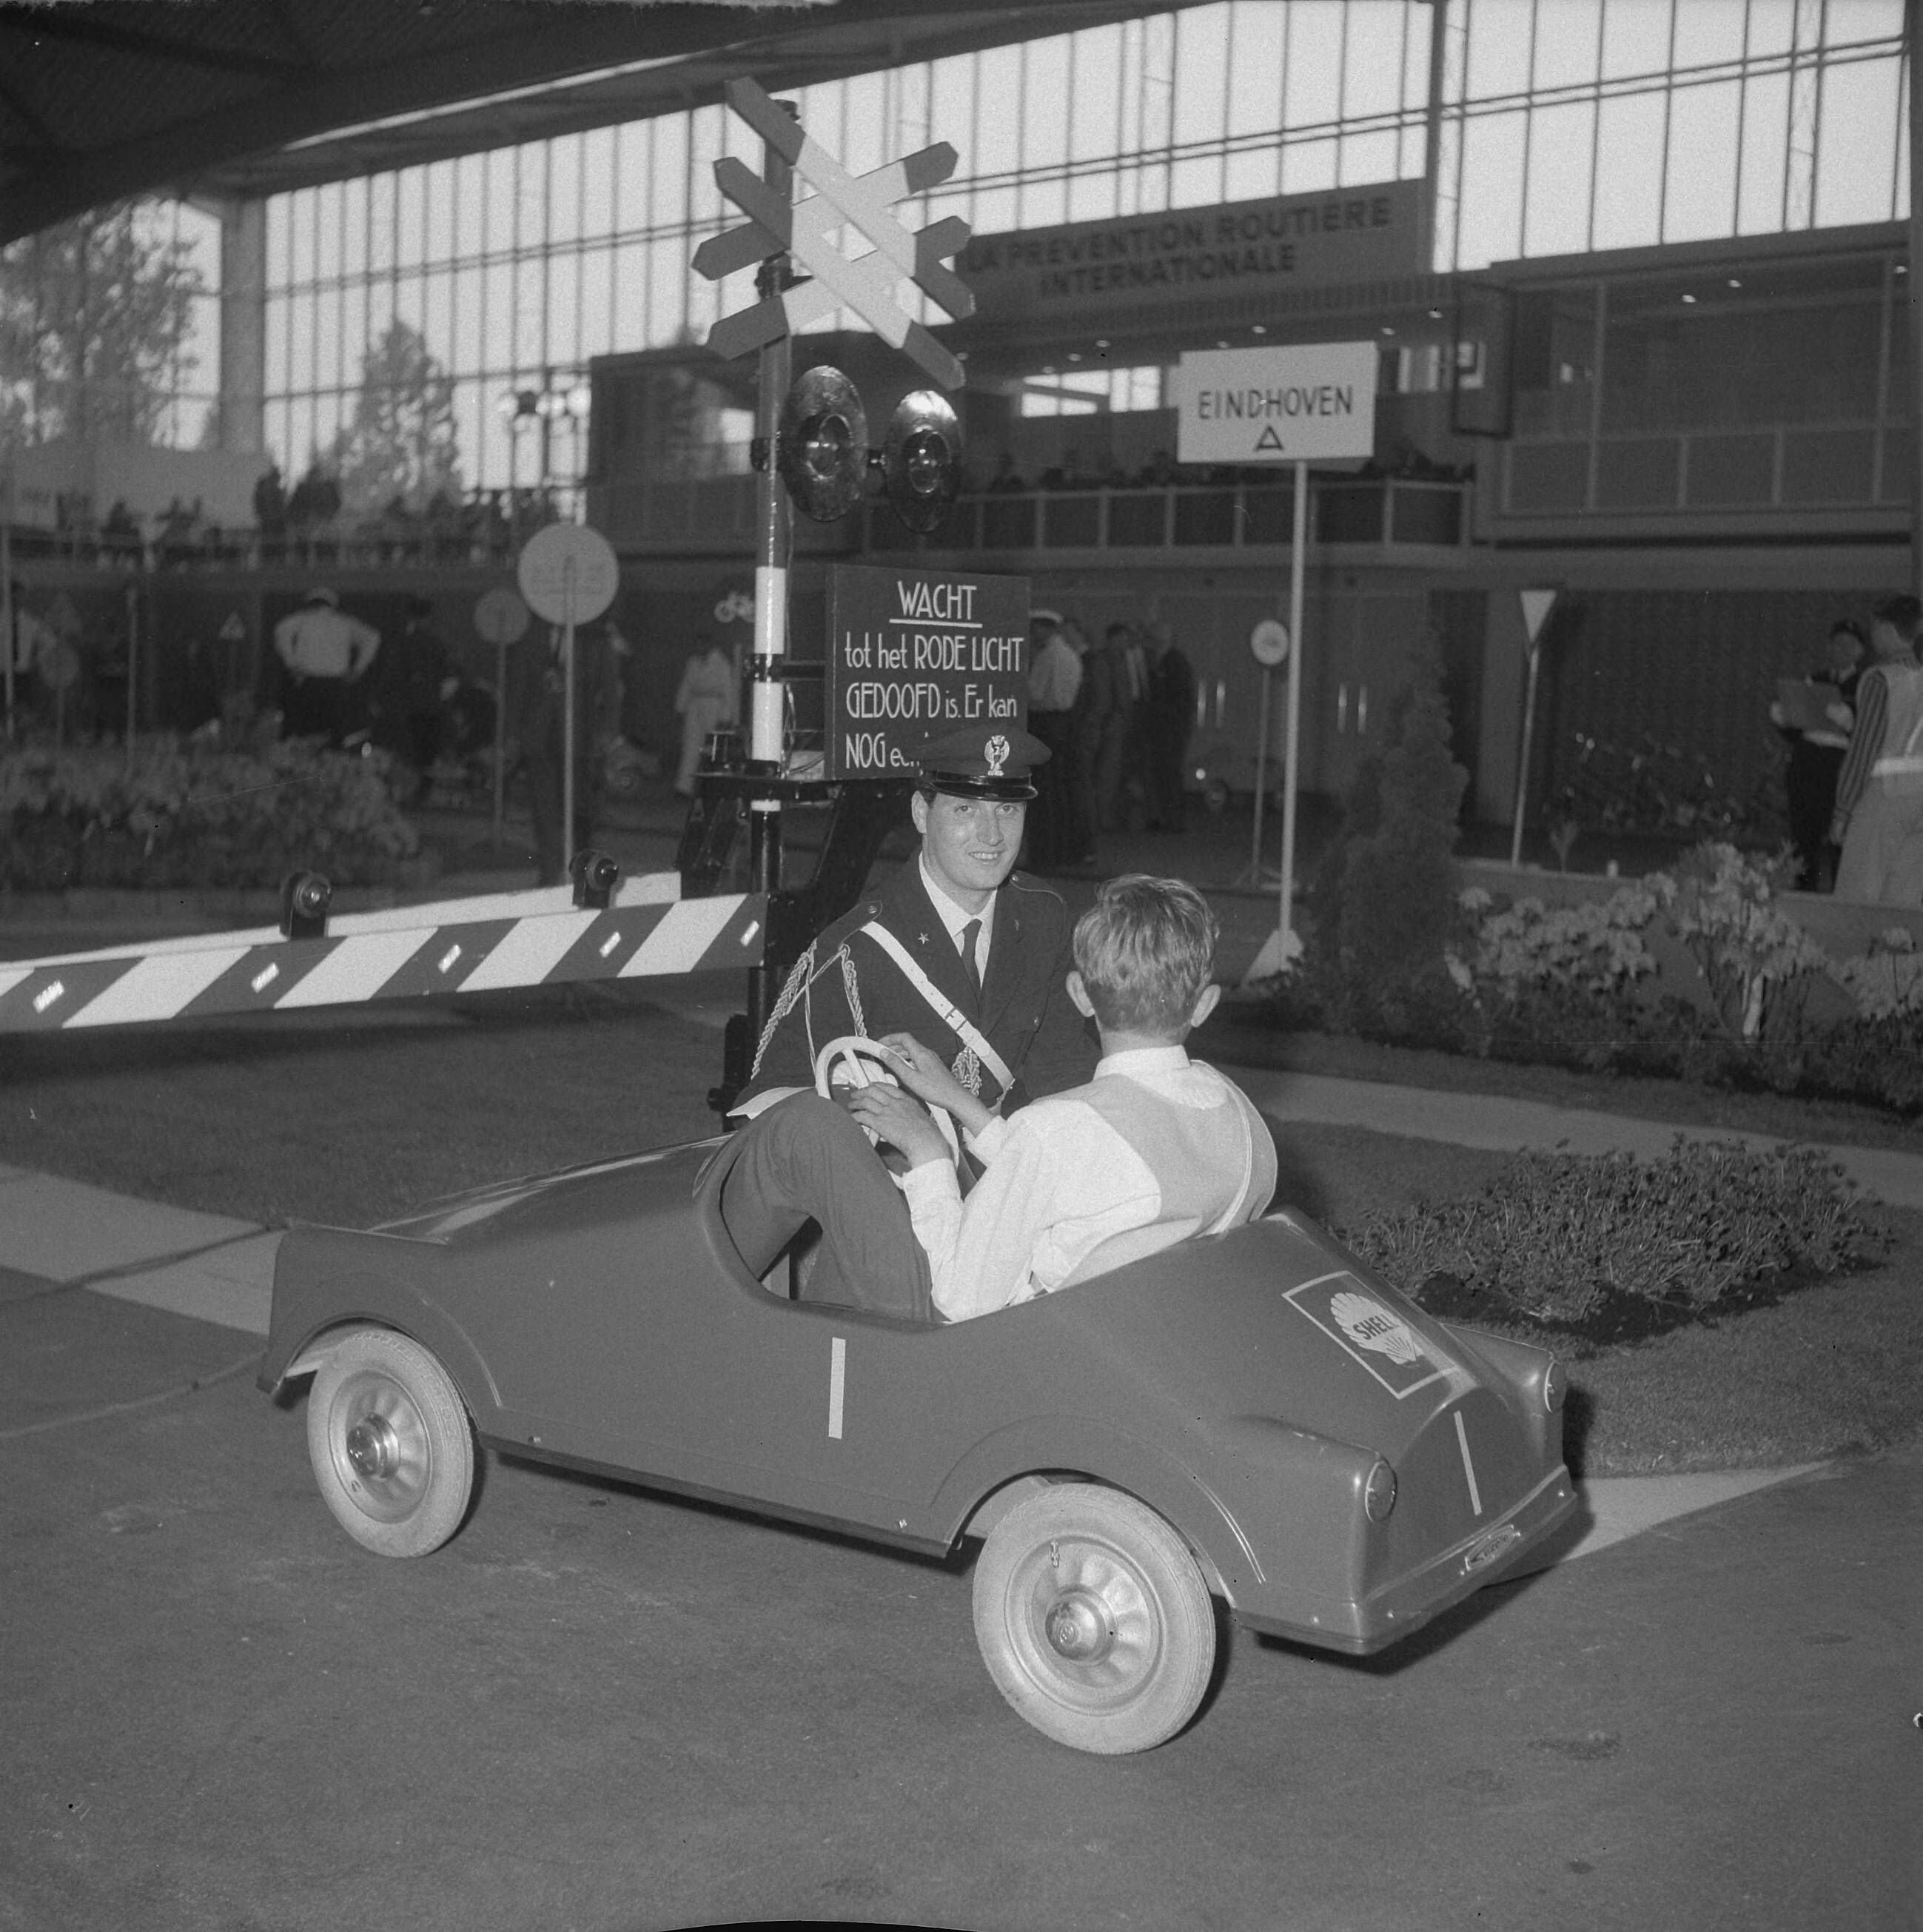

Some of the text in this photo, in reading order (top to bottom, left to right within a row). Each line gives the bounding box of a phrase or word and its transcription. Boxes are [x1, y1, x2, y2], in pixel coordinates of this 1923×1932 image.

[1041, 244, 1295, 297] INTERNATIONALE
[1198, 386, 1353, 419] EINDHOVEN
[897, 580, 977, 620] WACHT
[845, 631, 1024, 671] tot het RODE LICHT
[846, 682, 1017, 718] GEDOOFD is. Er kan
[846, 732, 886, 768] NOG
[1352, 1313, 1400, 1340] SHELL
